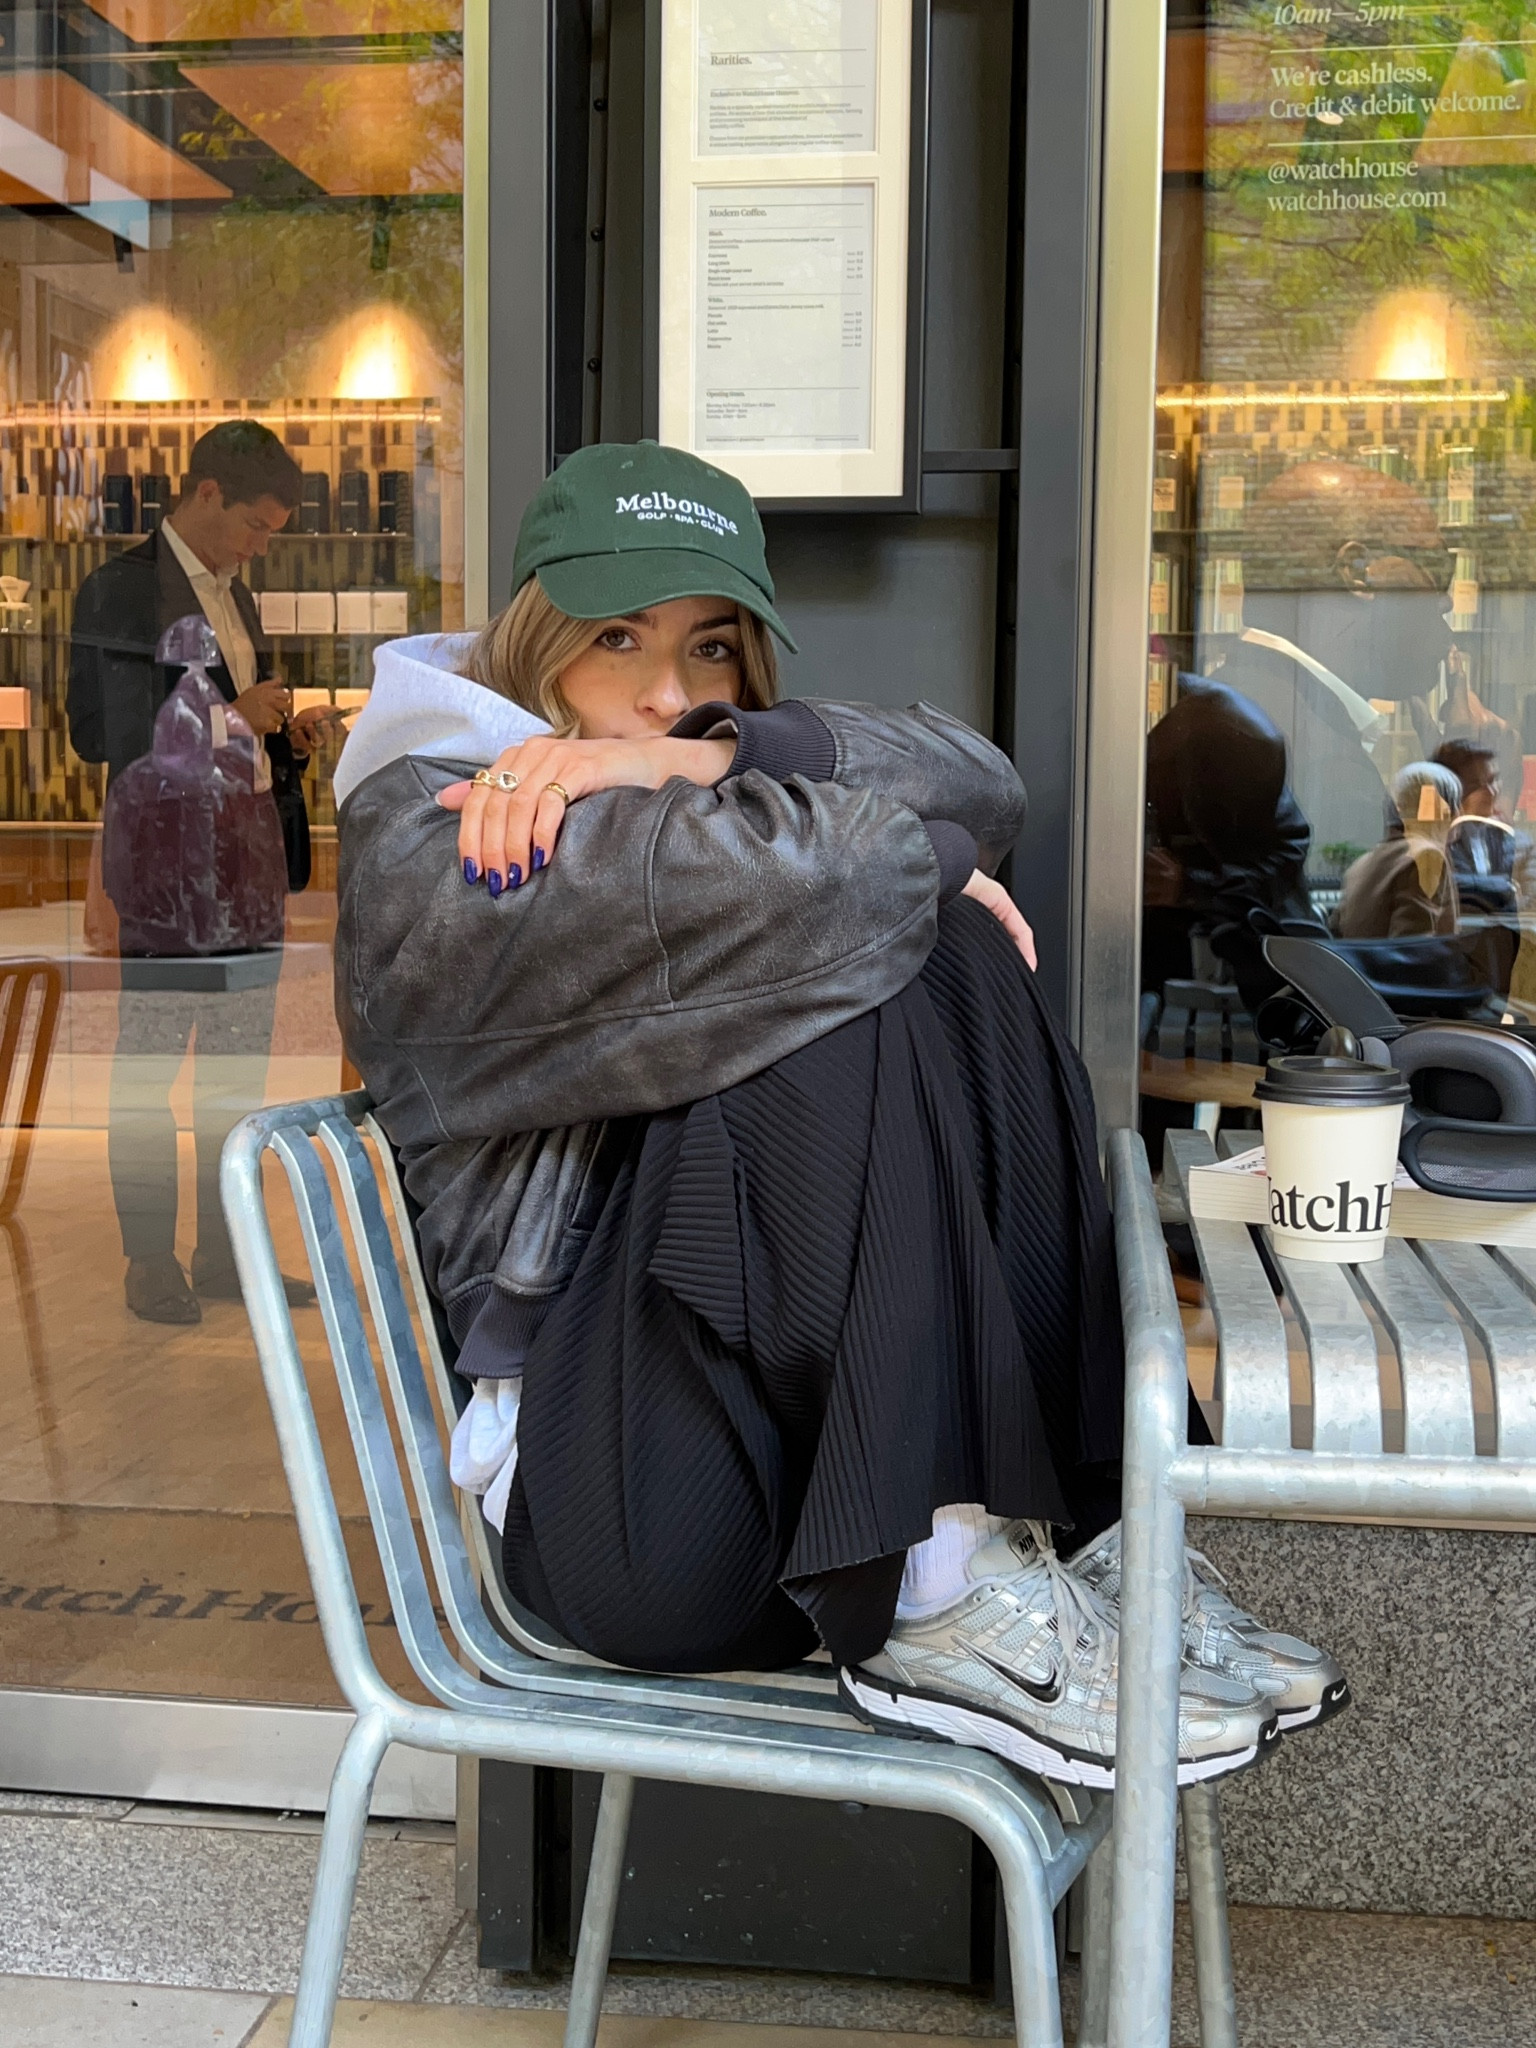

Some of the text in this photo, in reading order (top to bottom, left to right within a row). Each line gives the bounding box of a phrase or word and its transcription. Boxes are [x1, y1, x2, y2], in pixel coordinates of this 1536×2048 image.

[710, 54, 752, 66] Rarities.
[1270, 62, 1433, 87] We're cashless.
[1269, 91, 1521, 119] Credit & debit welcome.
[1268, 157, 1418, 183] @watchhouse
[709, 208, 767, 217] Modern Coffee.
[1267, 188, 1447, 212] watchhouse.com
[615, 492, 739, 535] Melbourne
[675, 514, 694, 524] SPA
[700, 520, 724, 536] CLUB
[1267, 1176, 1394, 1232] atchH
